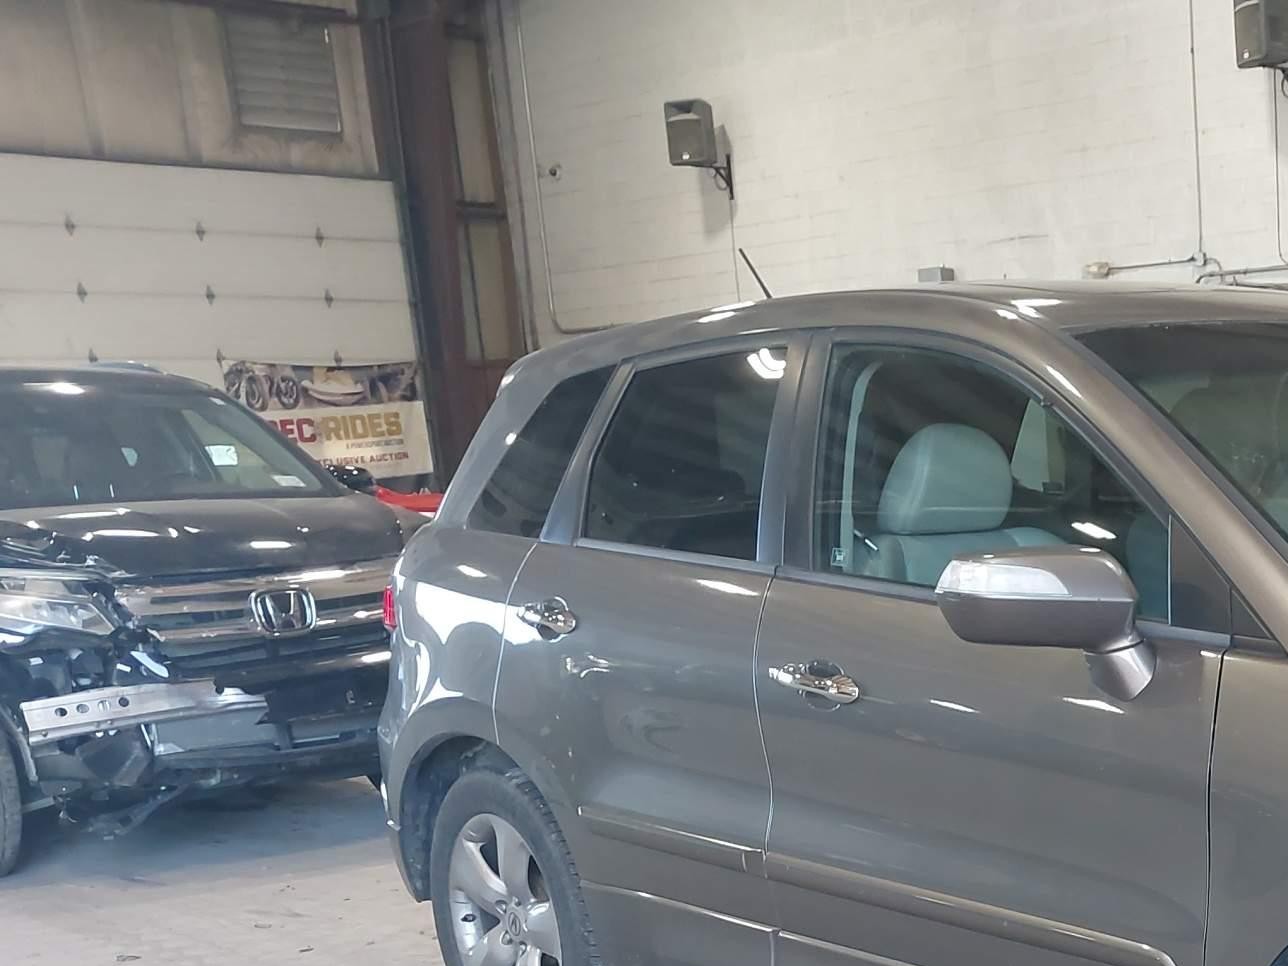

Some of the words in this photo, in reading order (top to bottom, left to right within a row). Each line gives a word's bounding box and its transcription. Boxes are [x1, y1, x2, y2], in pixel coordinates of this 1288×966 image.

[268, 418, 317, 443] EC
[320, 412, 402, 440] RIDES
[369, 452, 409, 463] AUCTION
